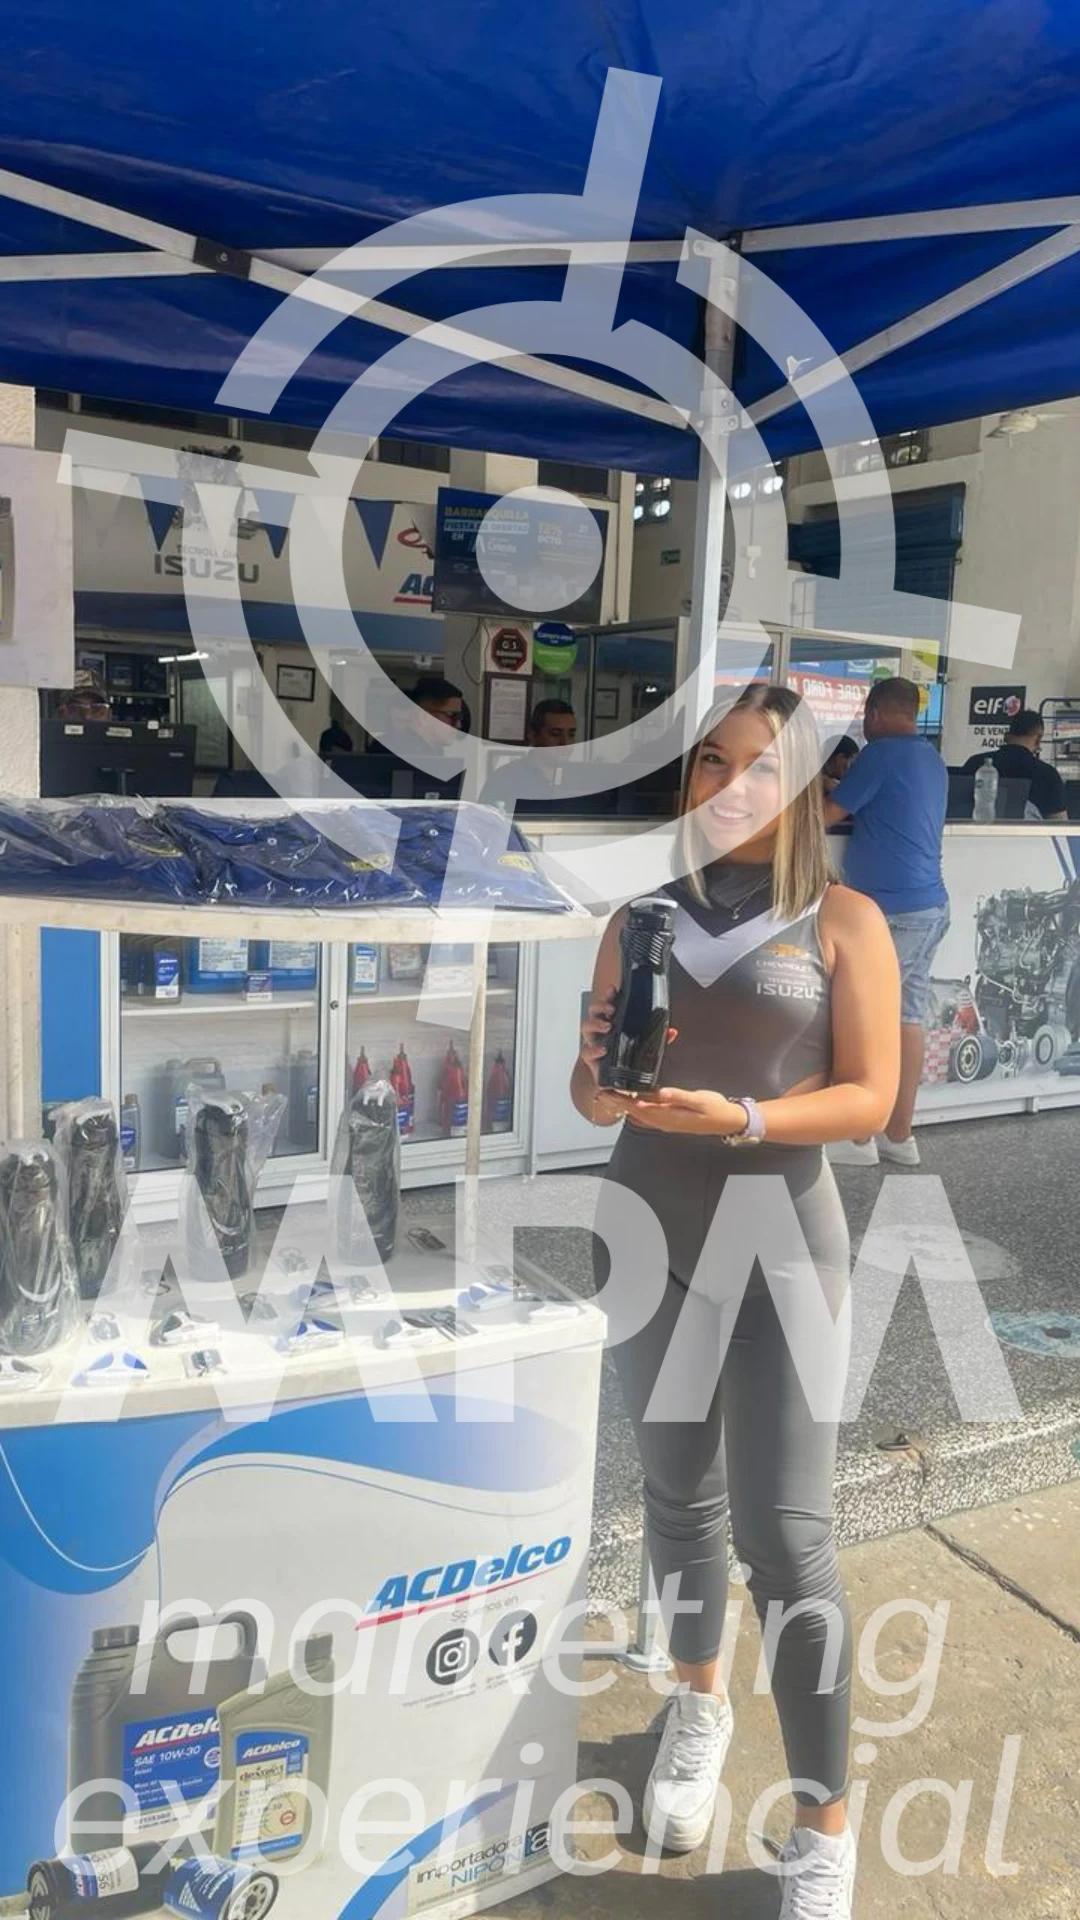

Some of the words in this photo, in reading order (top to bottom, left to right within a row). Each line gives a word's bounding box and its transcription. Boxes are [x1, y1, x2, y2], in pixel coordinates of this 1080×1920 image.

[154, 553, 260, 584] ISUZU
[974, 698, 1003, 714] elf
[974, 727, 986, 736] DE
[757, 982, 815, 999] ISUZU
[364, 1536, 572, 1614] ACDelco
[134, 1754, 156, 1768] SAE
[159, 1745, 201, 1763] 10W-30
[242, 1739, 301, 1759] ACDelco
[416, 1834, 523, 1884] importadora
